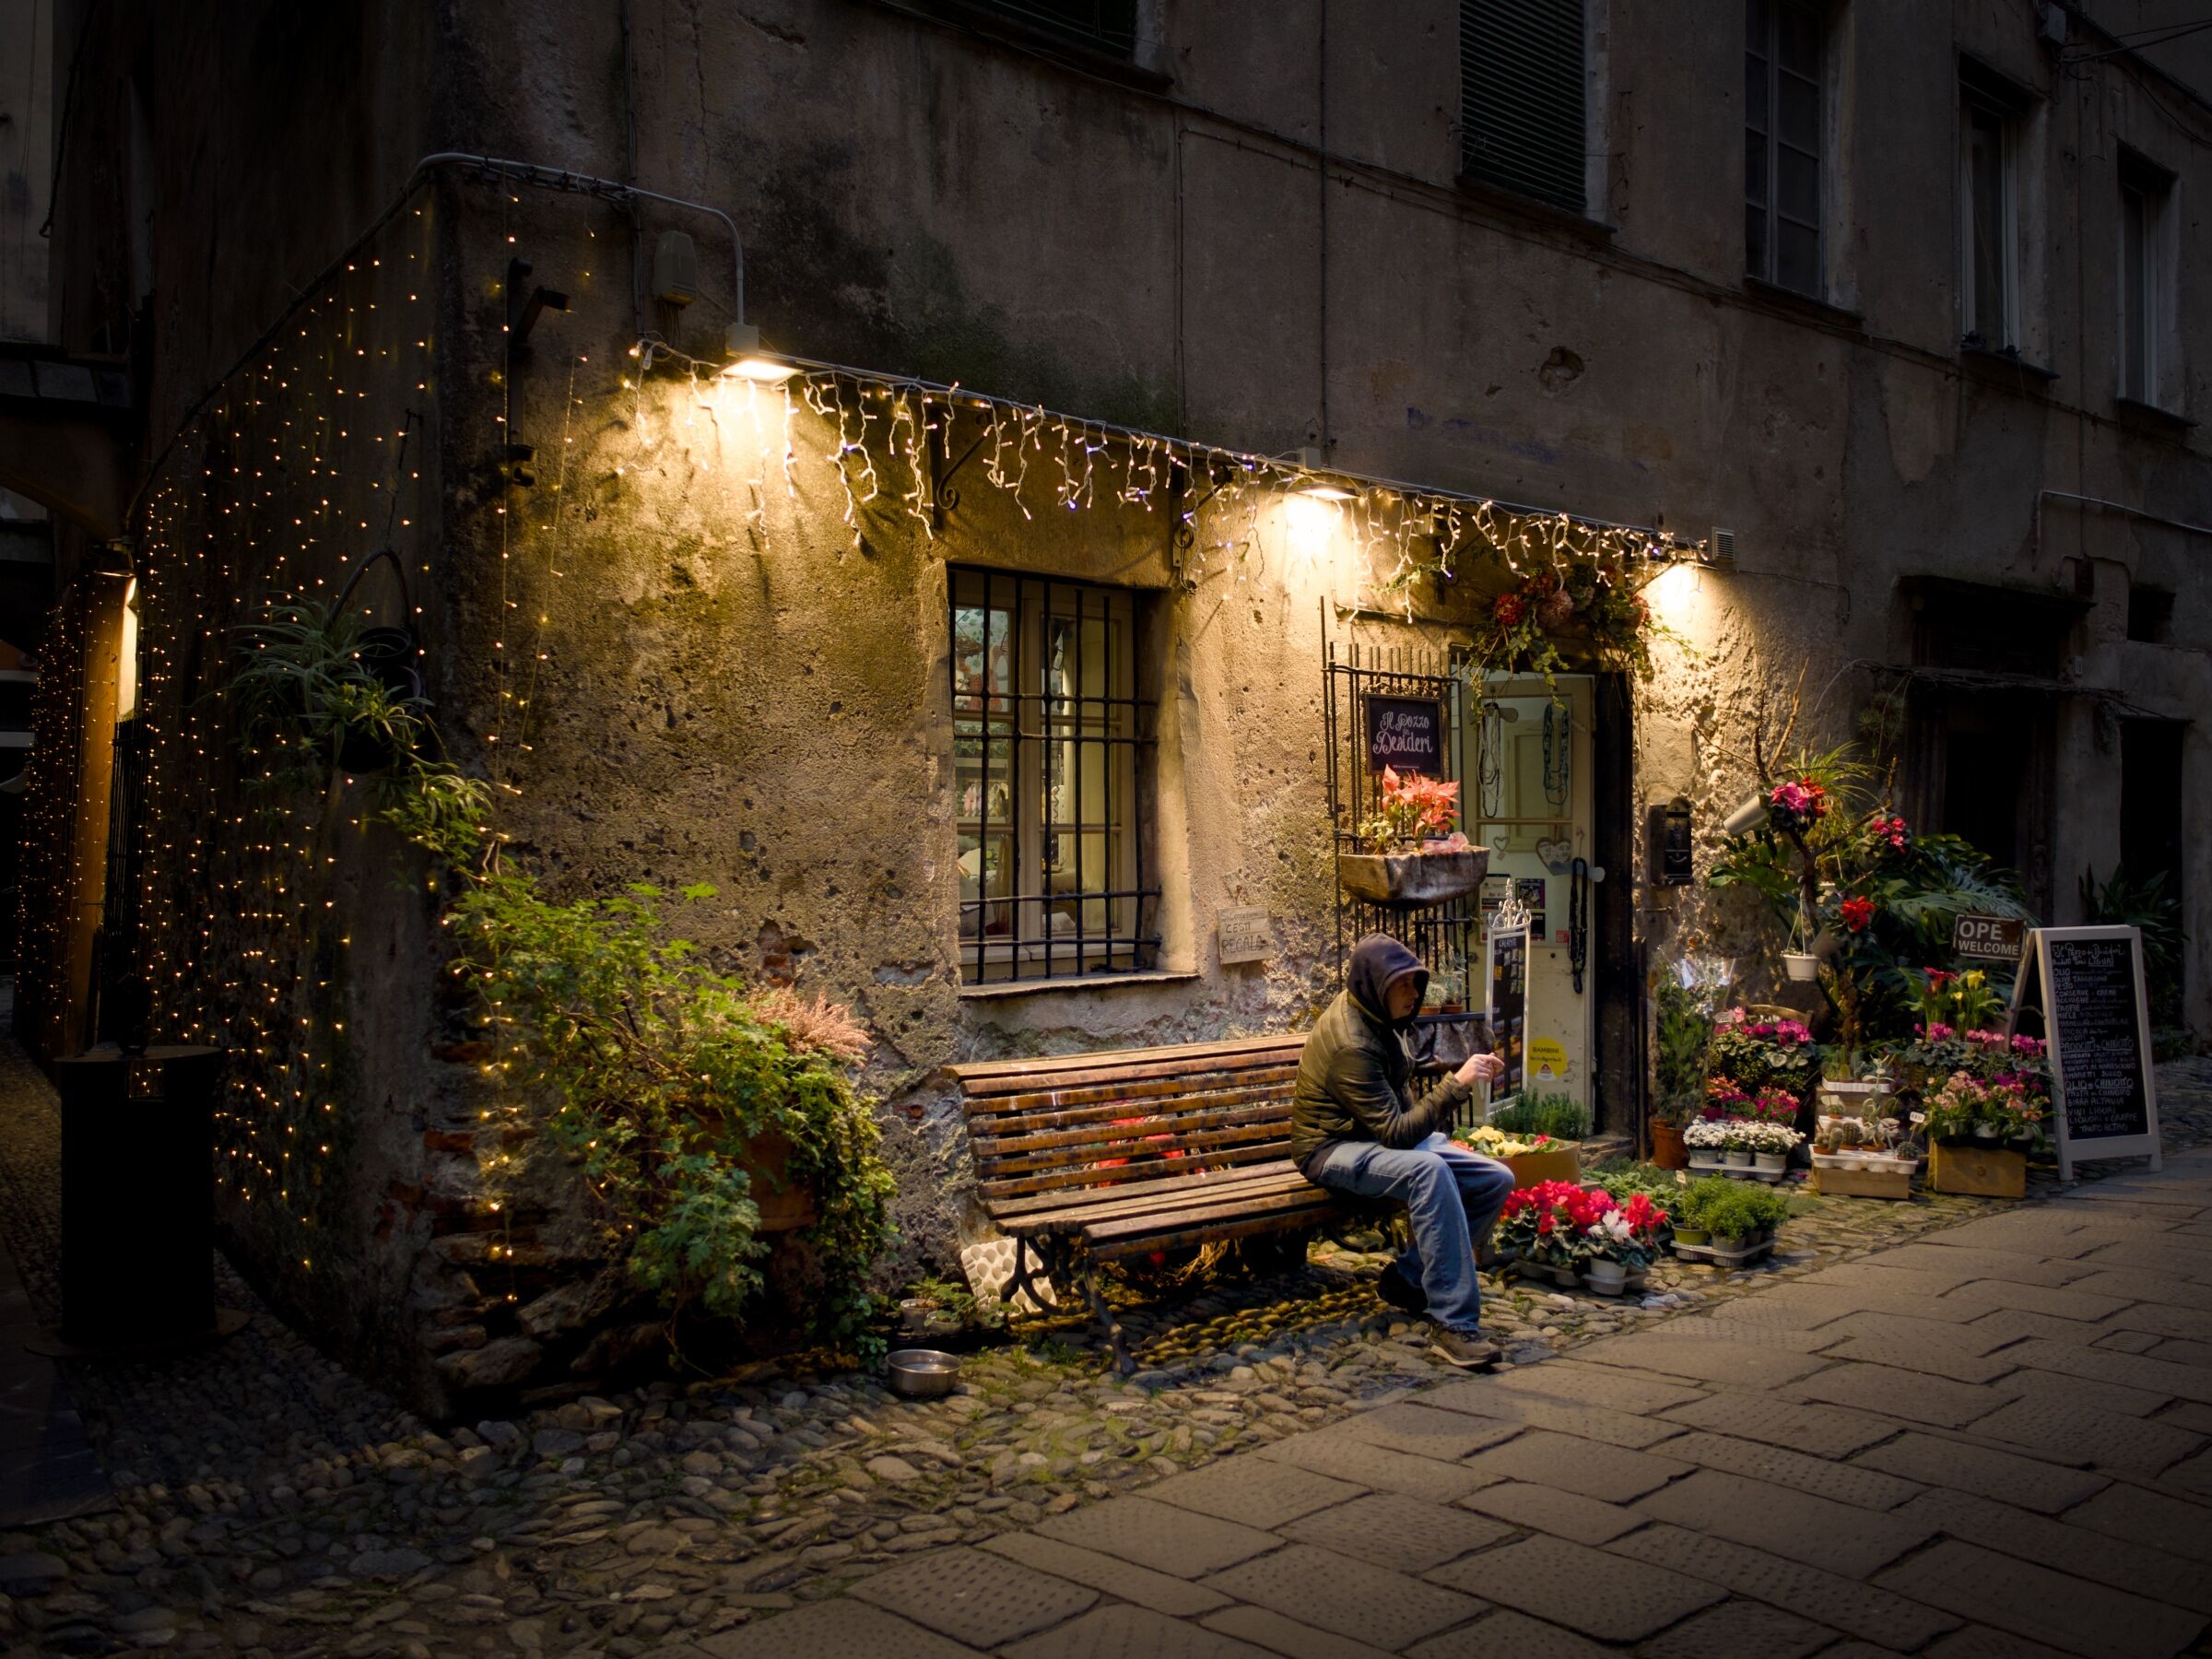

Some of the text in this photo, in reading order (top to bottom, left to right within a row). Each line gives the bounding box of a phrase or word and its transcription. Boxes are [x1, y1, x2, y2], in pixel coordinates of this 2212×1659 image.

[1380, 711, 1430, 732] Il Pozzo
[1372, 731, 1433, 755] Desideri
[1225, 922, 1251, 934] CESTI
[1959, 921, 2015, 942] OPE
[1958, 939, 2019, 956] WELCOME
[2053, 968, 2071, 977] OLIO
[2094, 1077, 2135, 1088] CHINOTTO
[2067, 1097, 2088, 1107] BIRRA
